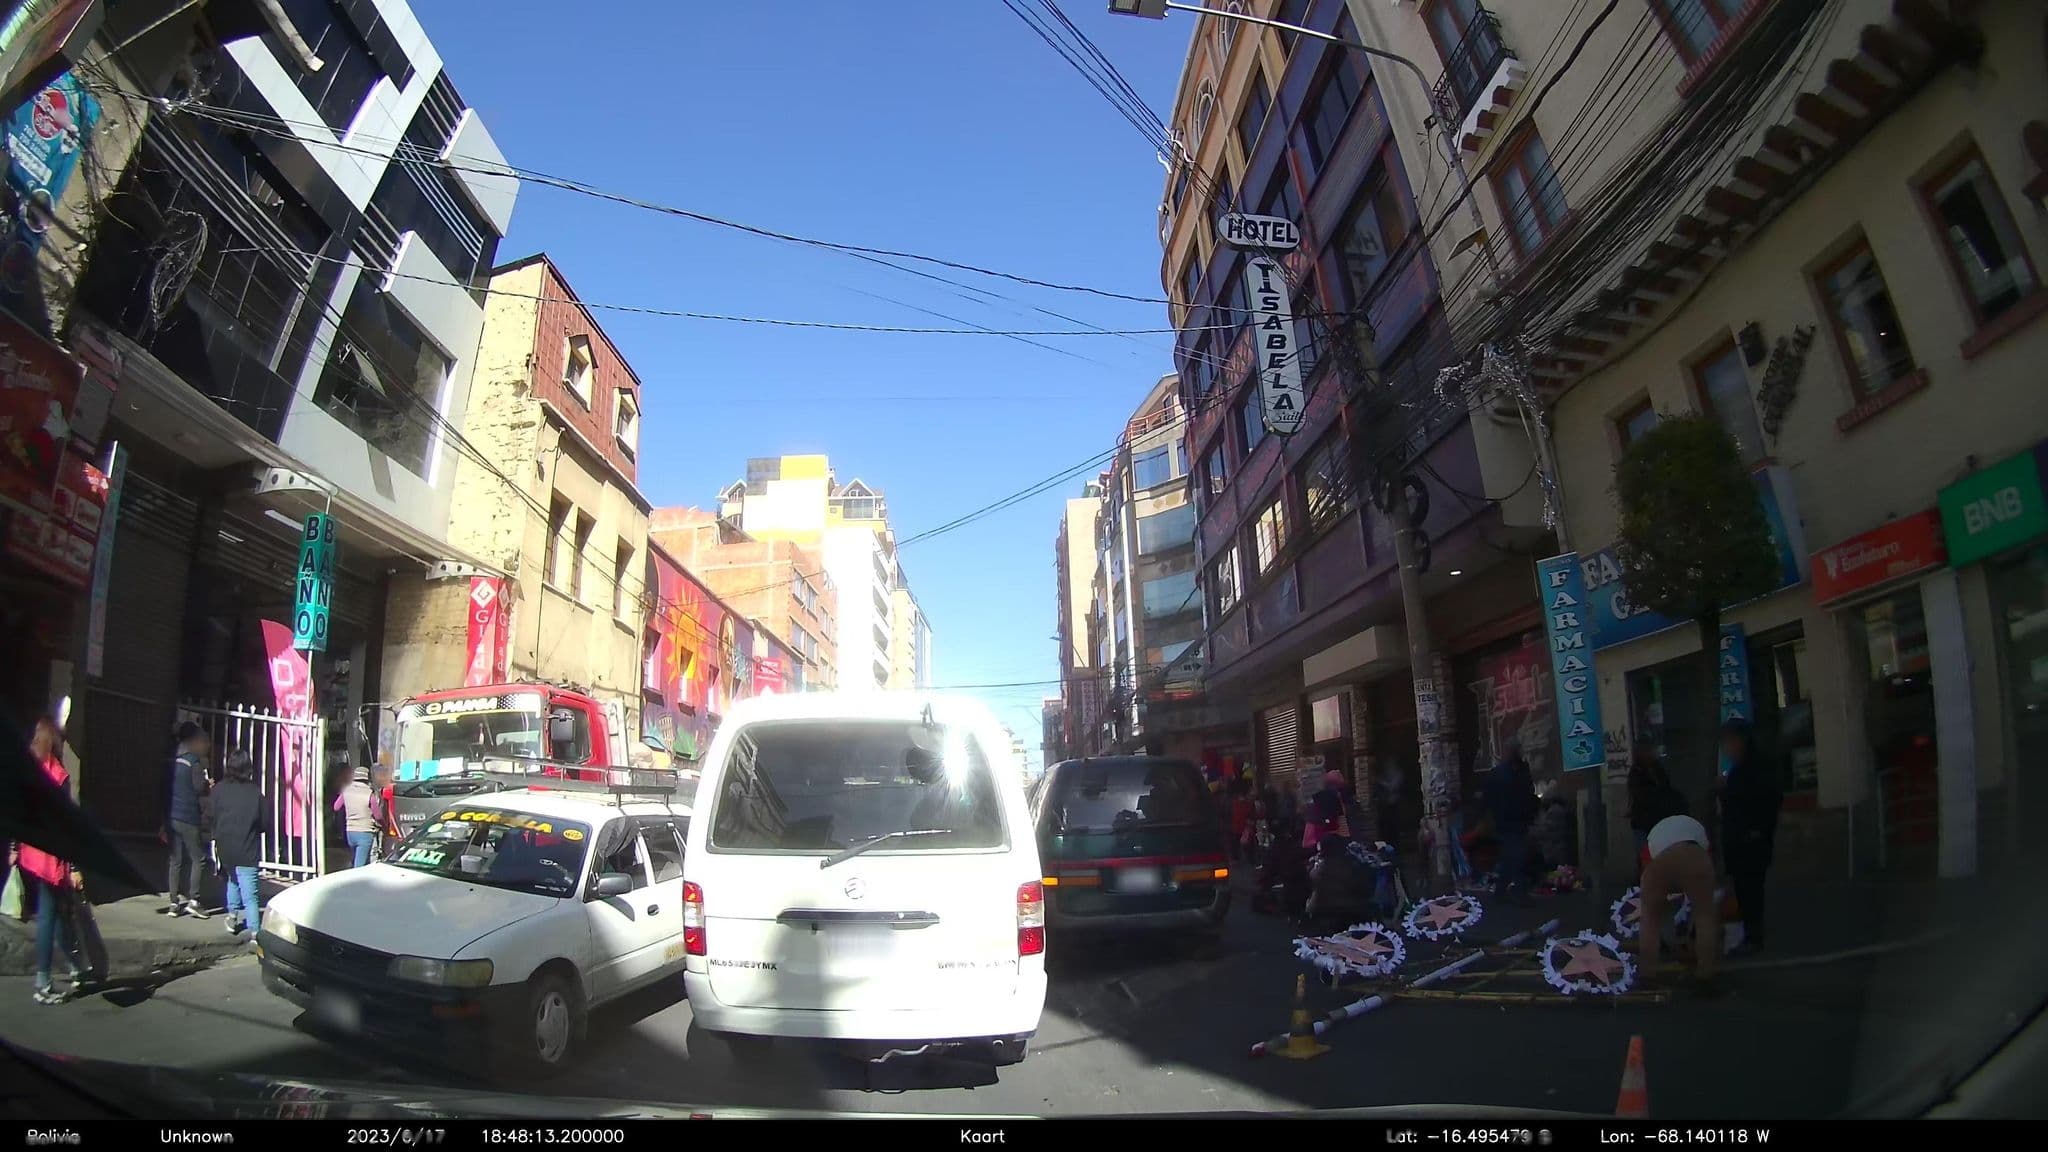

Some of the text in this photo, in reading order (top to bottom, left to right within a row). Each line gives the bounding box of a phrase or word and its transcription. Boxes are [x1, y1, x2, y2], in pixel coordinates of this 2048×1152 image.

[1227, 218, 1298, 243] HOTEL
[1253, 263, 1295, 410] ISABELA
[1963, 486, 2023, 536] BNB
[1548, 569, 1595, 738] FARMACIA
